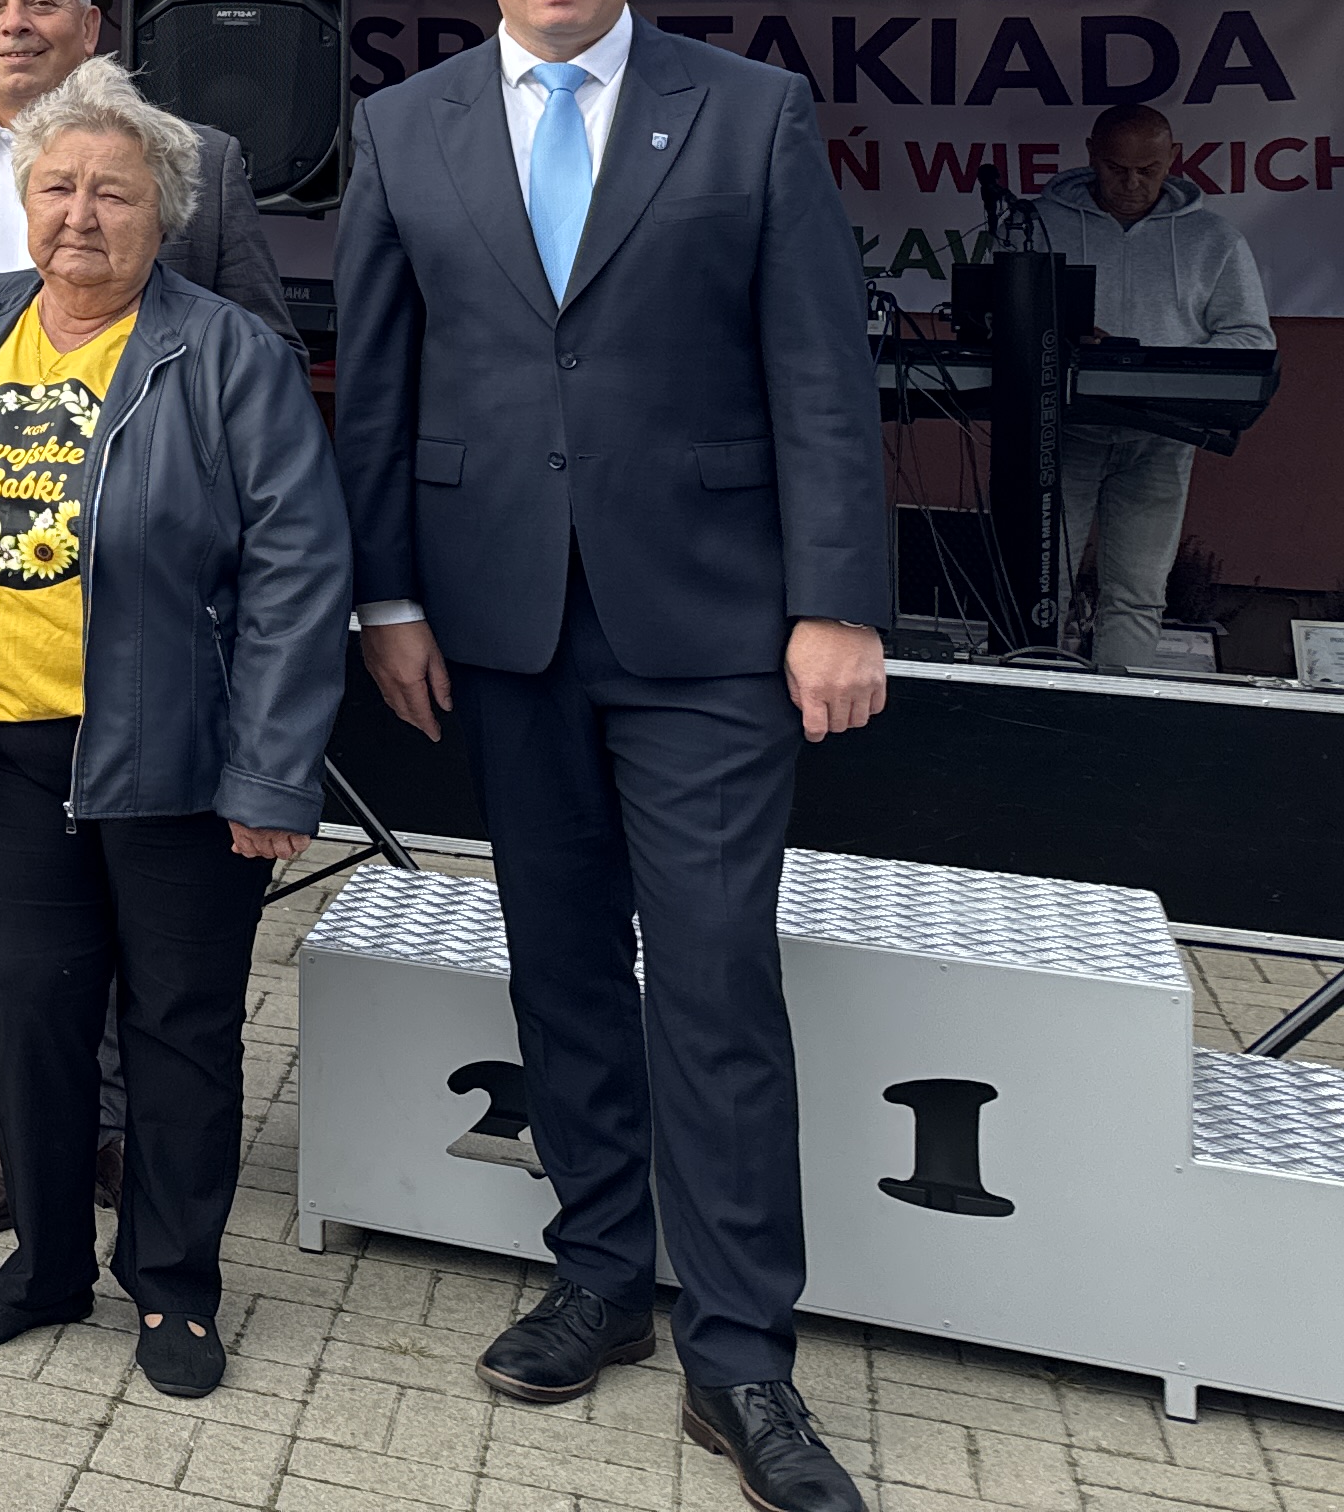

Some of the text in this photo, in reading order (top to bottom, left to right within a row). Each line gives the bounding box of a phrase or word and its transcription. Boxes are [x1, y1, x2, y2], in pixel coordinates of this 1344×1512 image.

[349, 10, 1296, 106] SPTAKIADA
[904, 136, 1344, 195] WIEKICH
[1040, 390, 1056, 486] SPIDER
[878, 1077, 1015, 1217] 1
